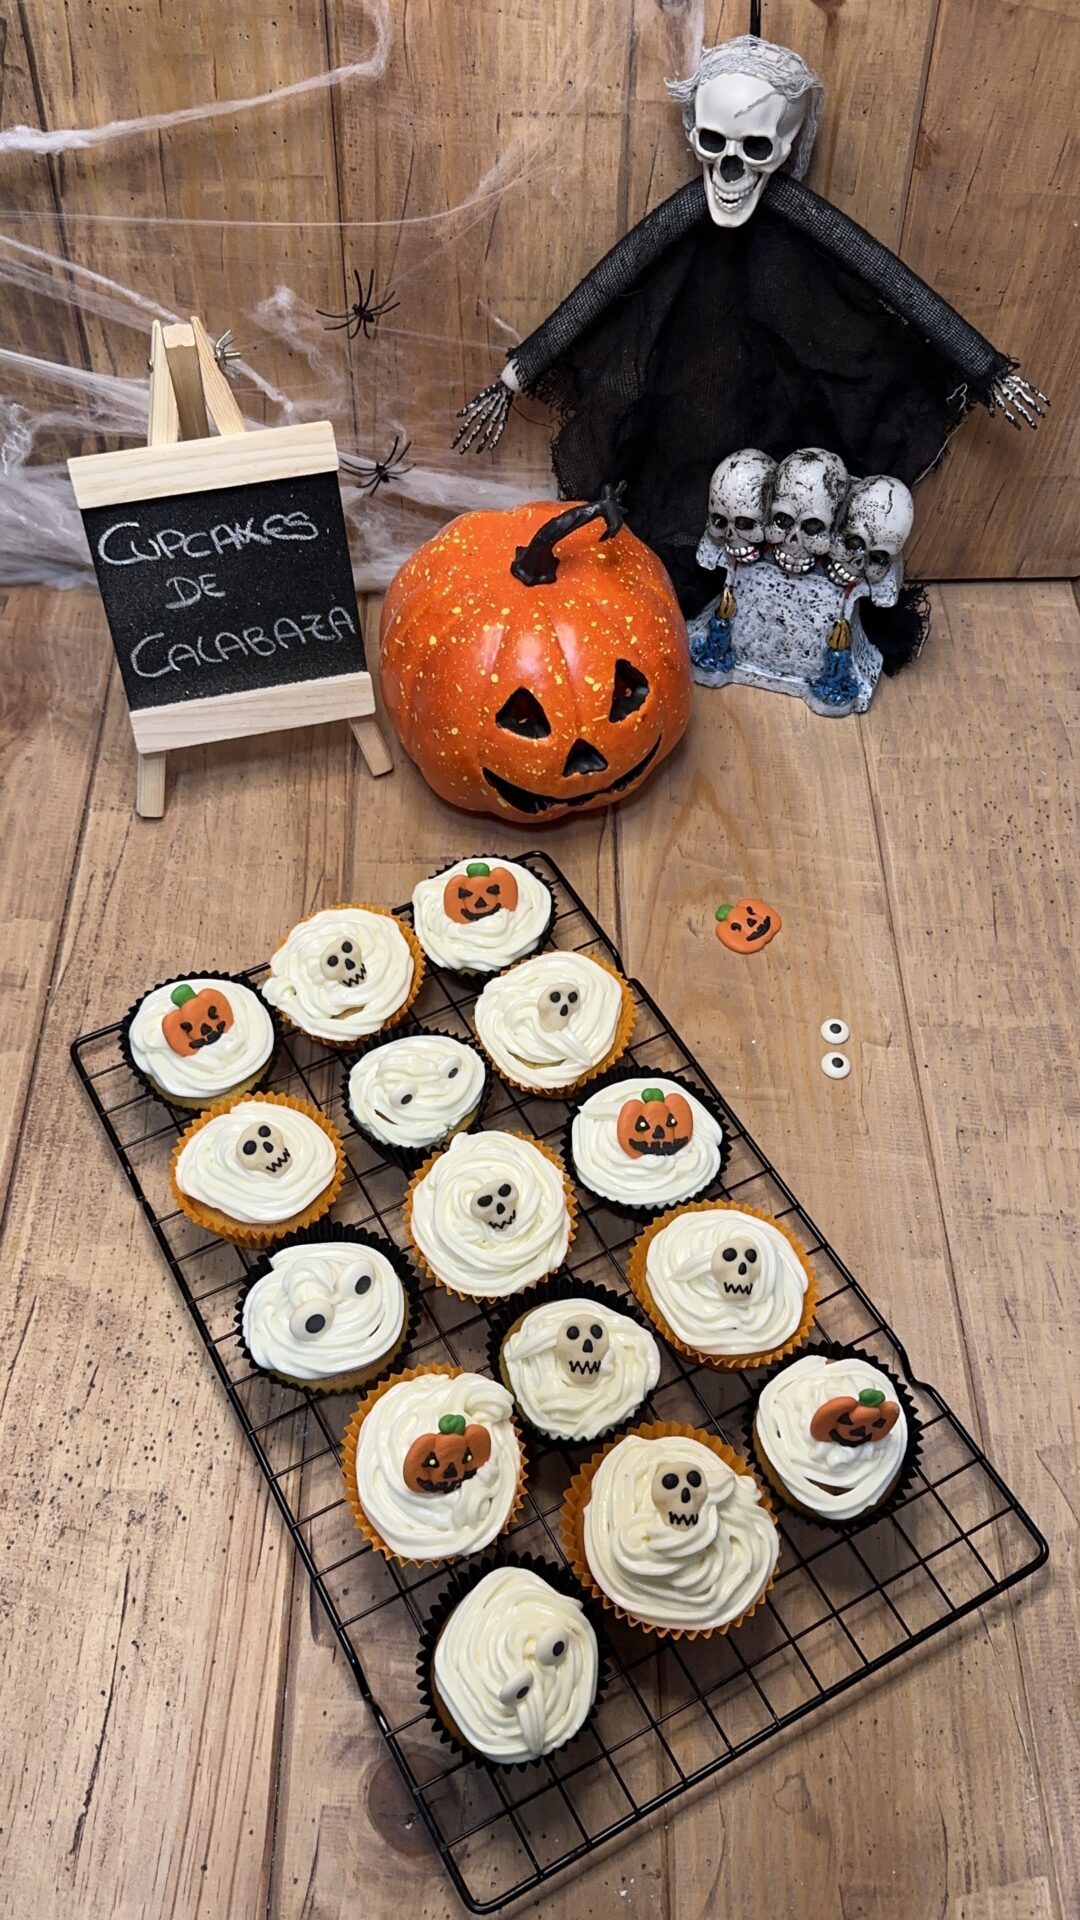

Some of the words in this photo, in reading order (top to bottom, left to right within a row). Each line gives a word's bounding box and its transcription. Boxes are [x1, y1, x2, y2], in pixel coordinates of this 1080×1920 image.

[98, 511, 319, 566] CUPCAKES
[165, 573, 226, 610] DE
[130, 606, 356, 678] CALABAZA
